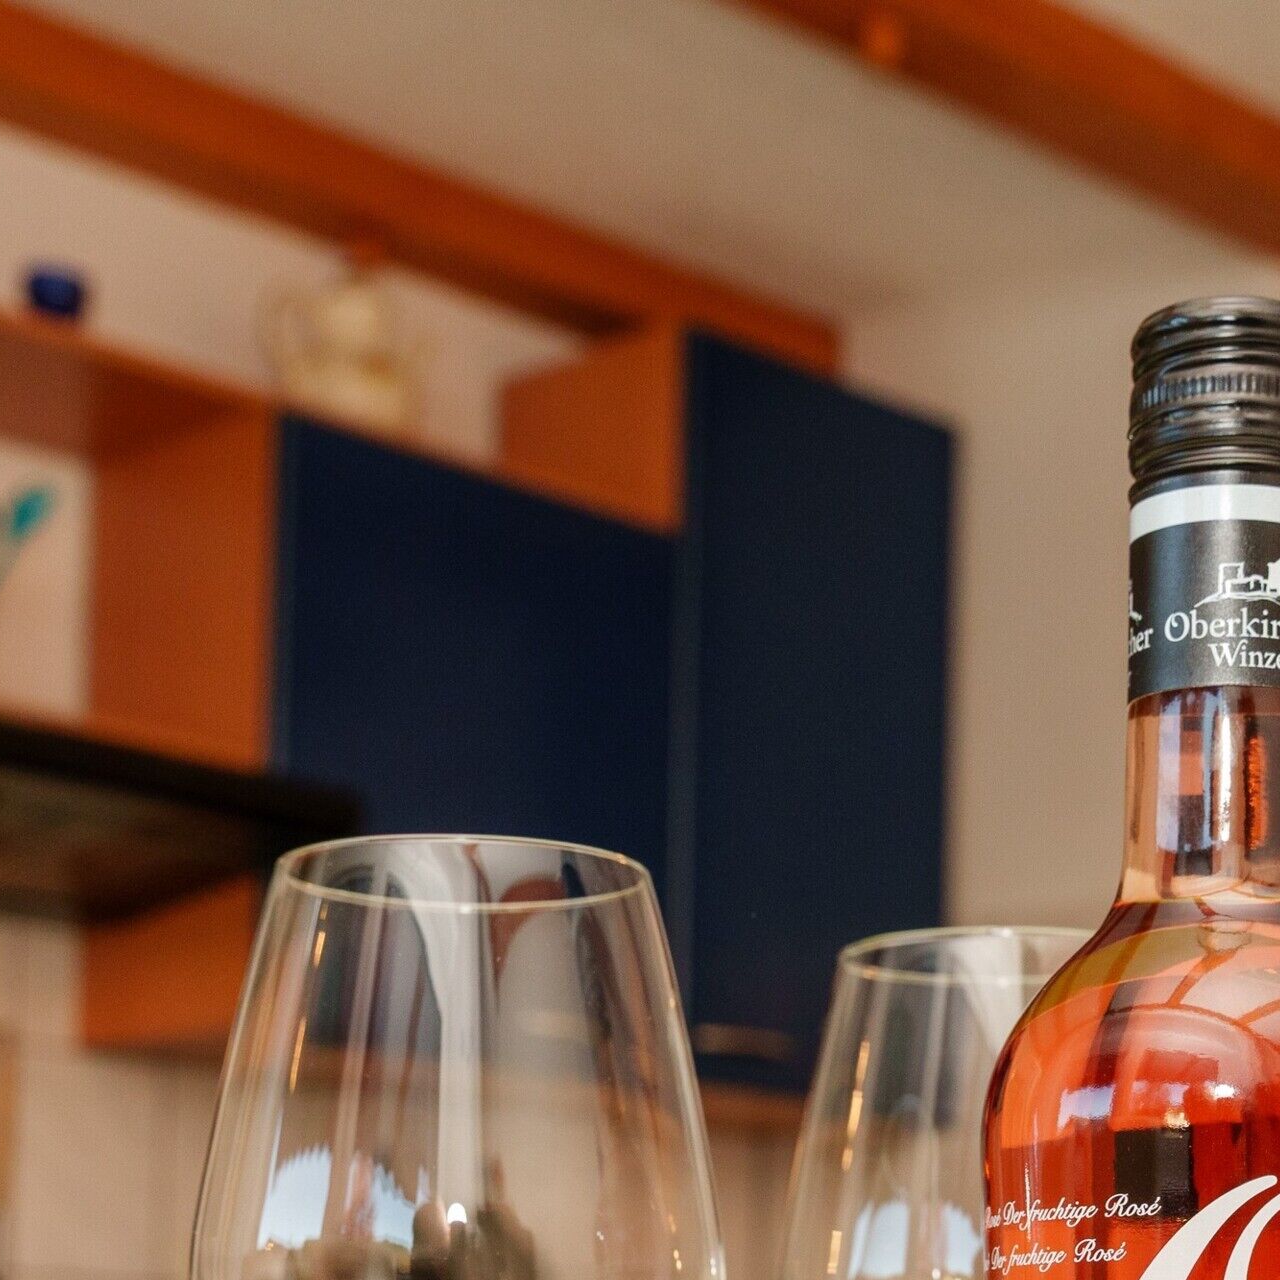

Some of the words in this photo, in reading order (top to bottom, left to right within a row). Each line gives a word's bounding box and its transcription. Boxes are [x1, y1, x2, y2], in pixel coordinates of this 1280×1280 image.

[1003, 1200, 1025, 1226] Der
[1019, 1197, 1098, 1231] fruchtige
[1104, 1193, 1162, 1218] Rosé
[991, 1247, 1006, 1270] Der
[1003, 1243, 1067, 1275] fruchtige
[1074, 1238, 1127, 1263] Rosé
